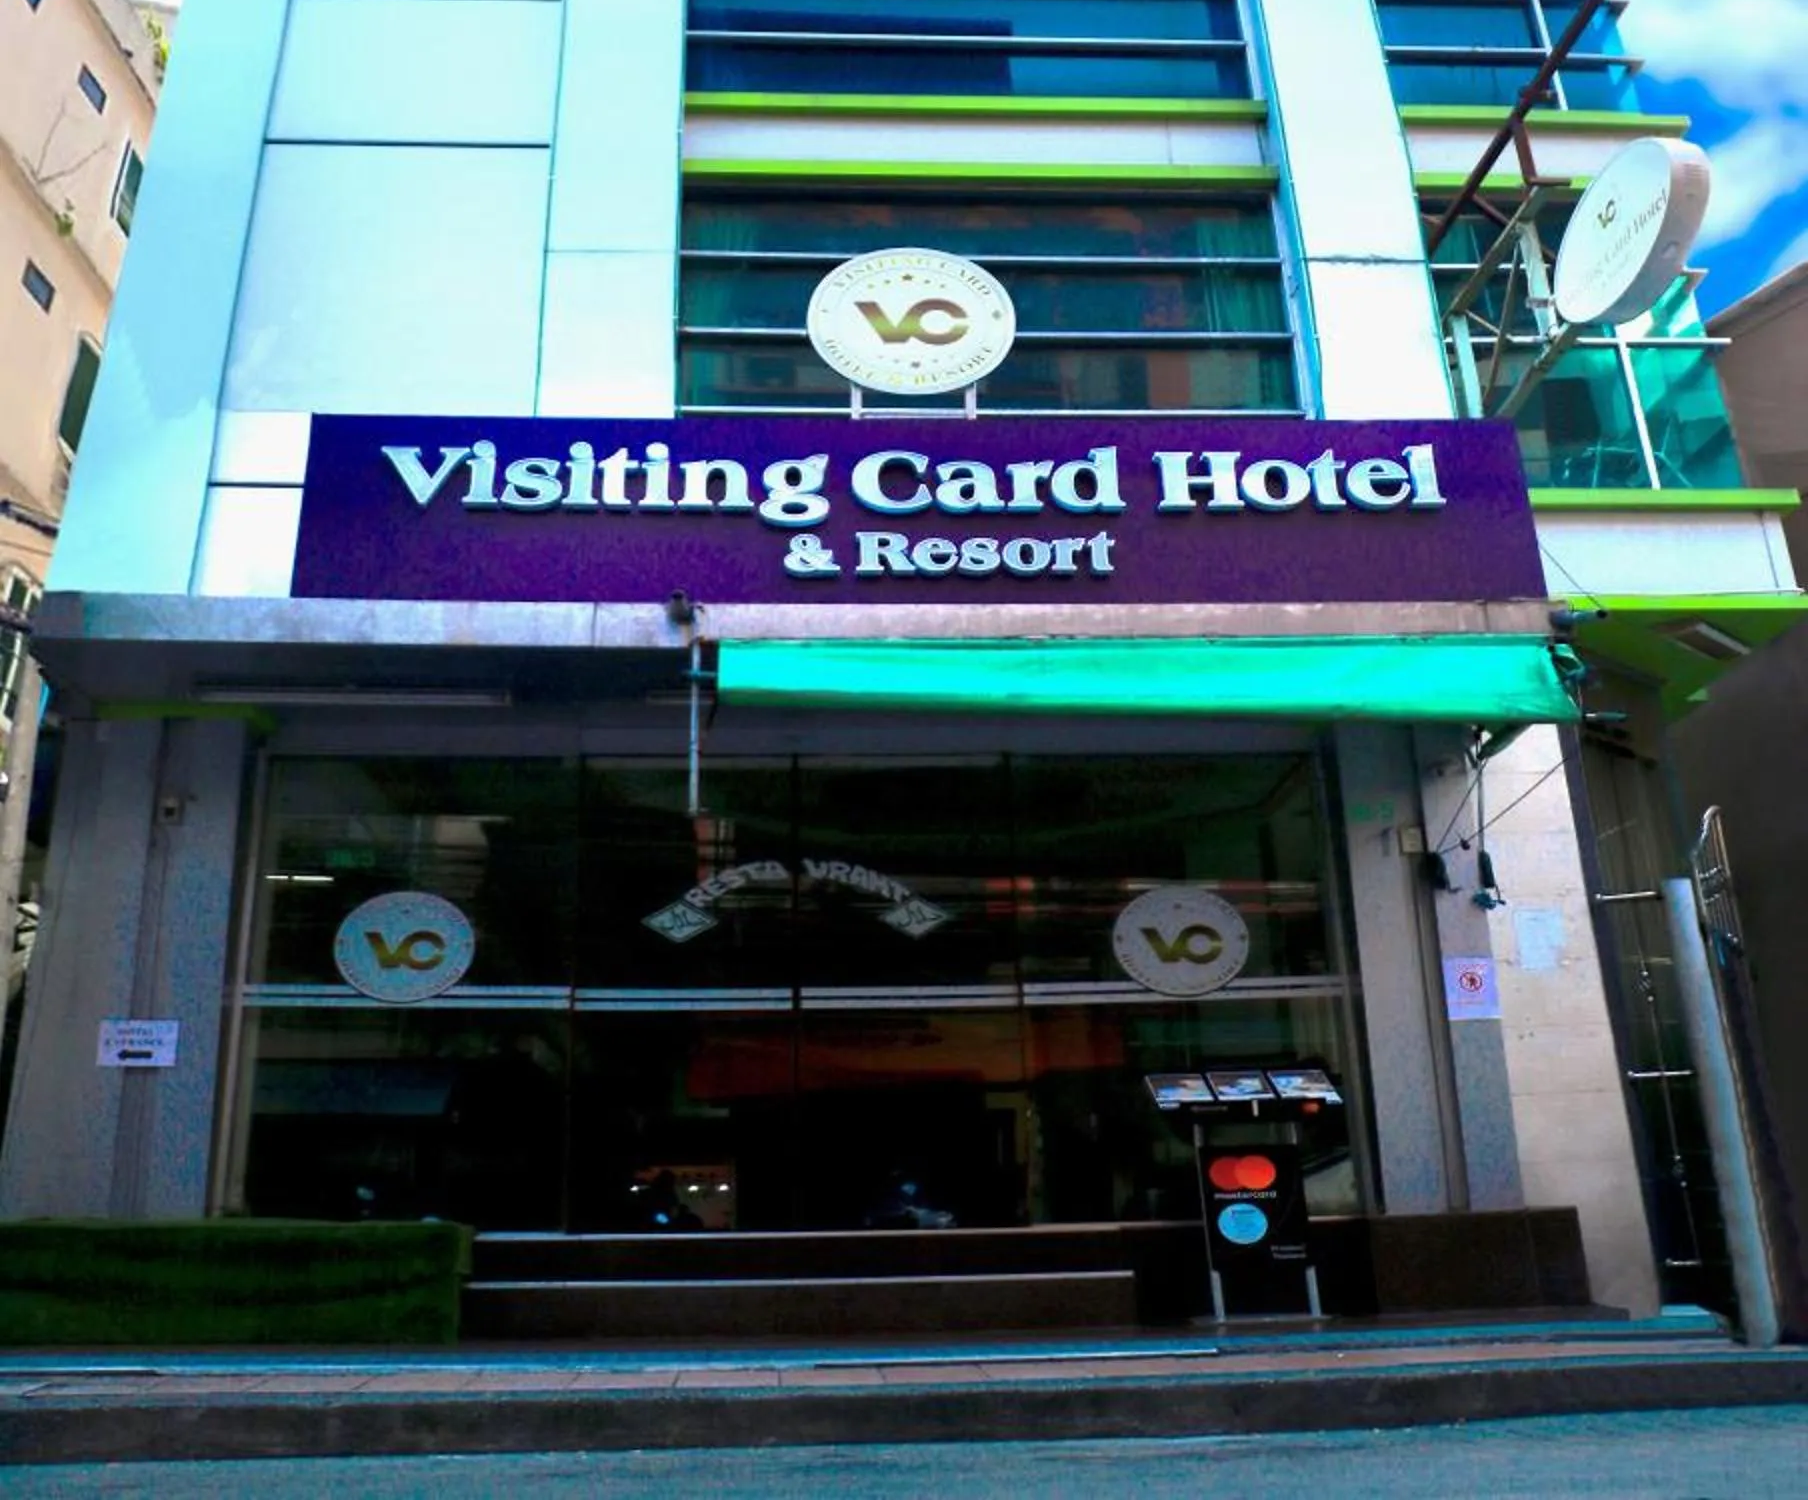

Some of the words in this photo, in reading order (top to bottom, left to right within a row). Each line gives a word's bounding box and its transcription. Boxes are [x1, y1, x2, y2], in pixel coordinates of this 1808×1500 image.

[853, 298, 970, 345] VC
[381, 439, 831, 528] Visiting
[850, 444, 1128, 516] Card
[1150, 442, 1448, 514] Hotel
[782, 532, 841, 579] &
[854, 530, 1116, 579] Resort
[364, 929, 447, 970] VC
[1139, 923, 1224, 965] VC
